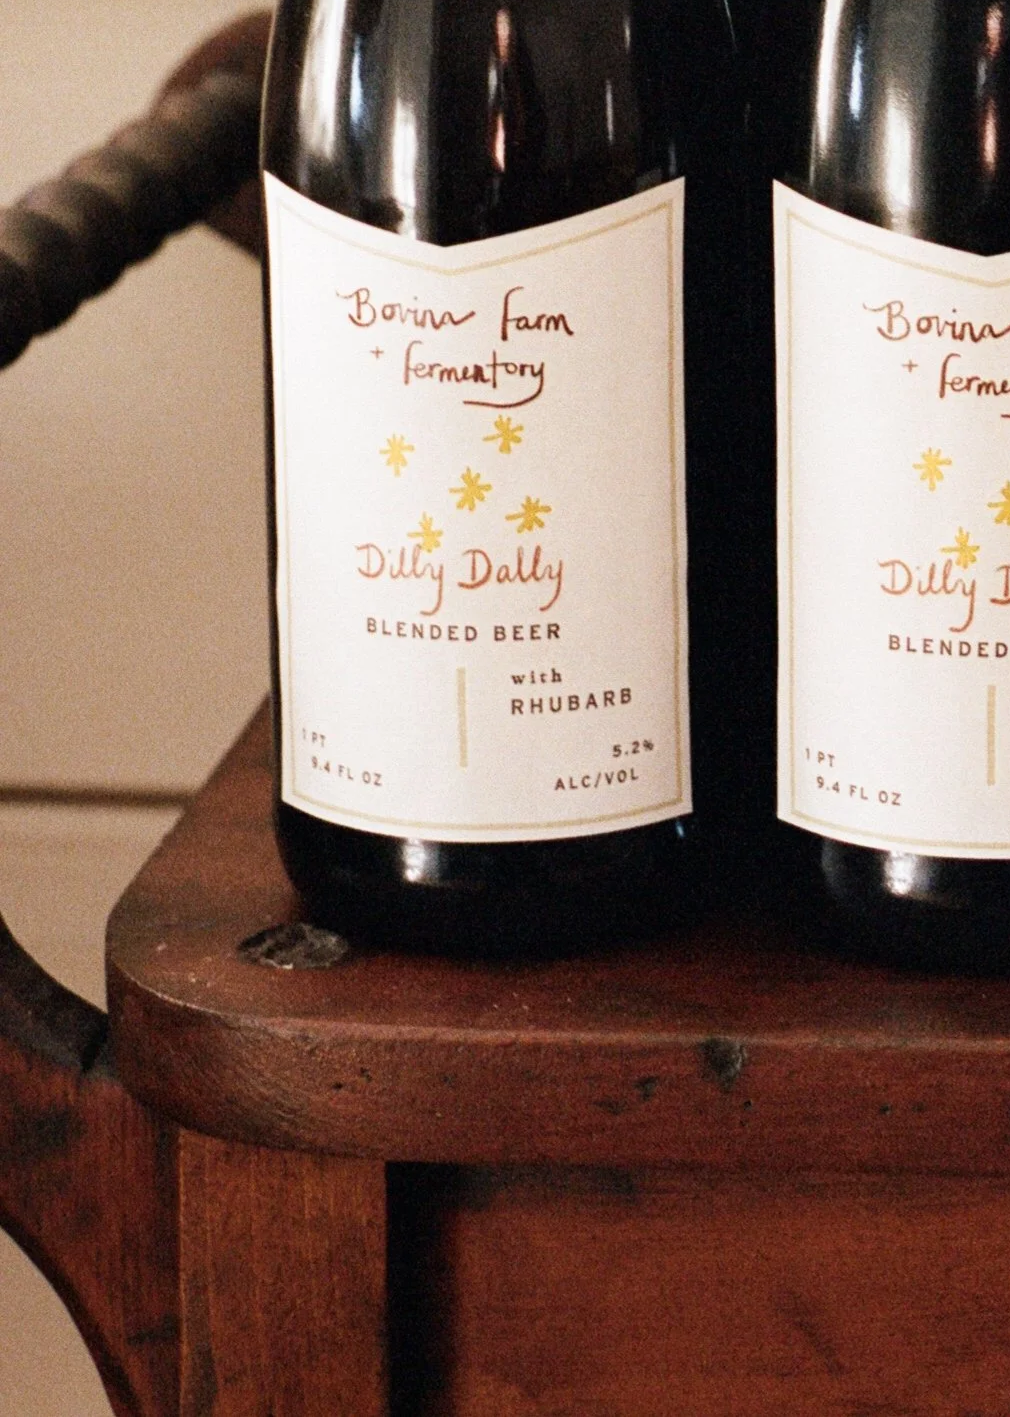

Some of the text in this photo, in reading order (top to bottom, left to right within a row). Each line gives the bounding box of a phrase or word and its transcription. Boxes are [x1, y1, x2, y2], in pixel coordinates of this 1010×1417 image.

[355, 543, 564, 616] Dilly Dally
[877, 558, 977, 632] Dilly
[366, 617, 561, 642] BLENDED BEER
[888, 633, 1009, 659] BLENDED
[511, 667, 562, 685] with
[510, 687, 632, 716] RHUBARB
[612, 740, 654, 758] 5.2%
[817, 751, 835, 767] PT
[338, 765, 353, 780] FL
[362, 771, 382, 787] OZ
[554, 768, 638, 791] ALC/VOL
[816, 775, 901, 806] 9.4 FL OZ
